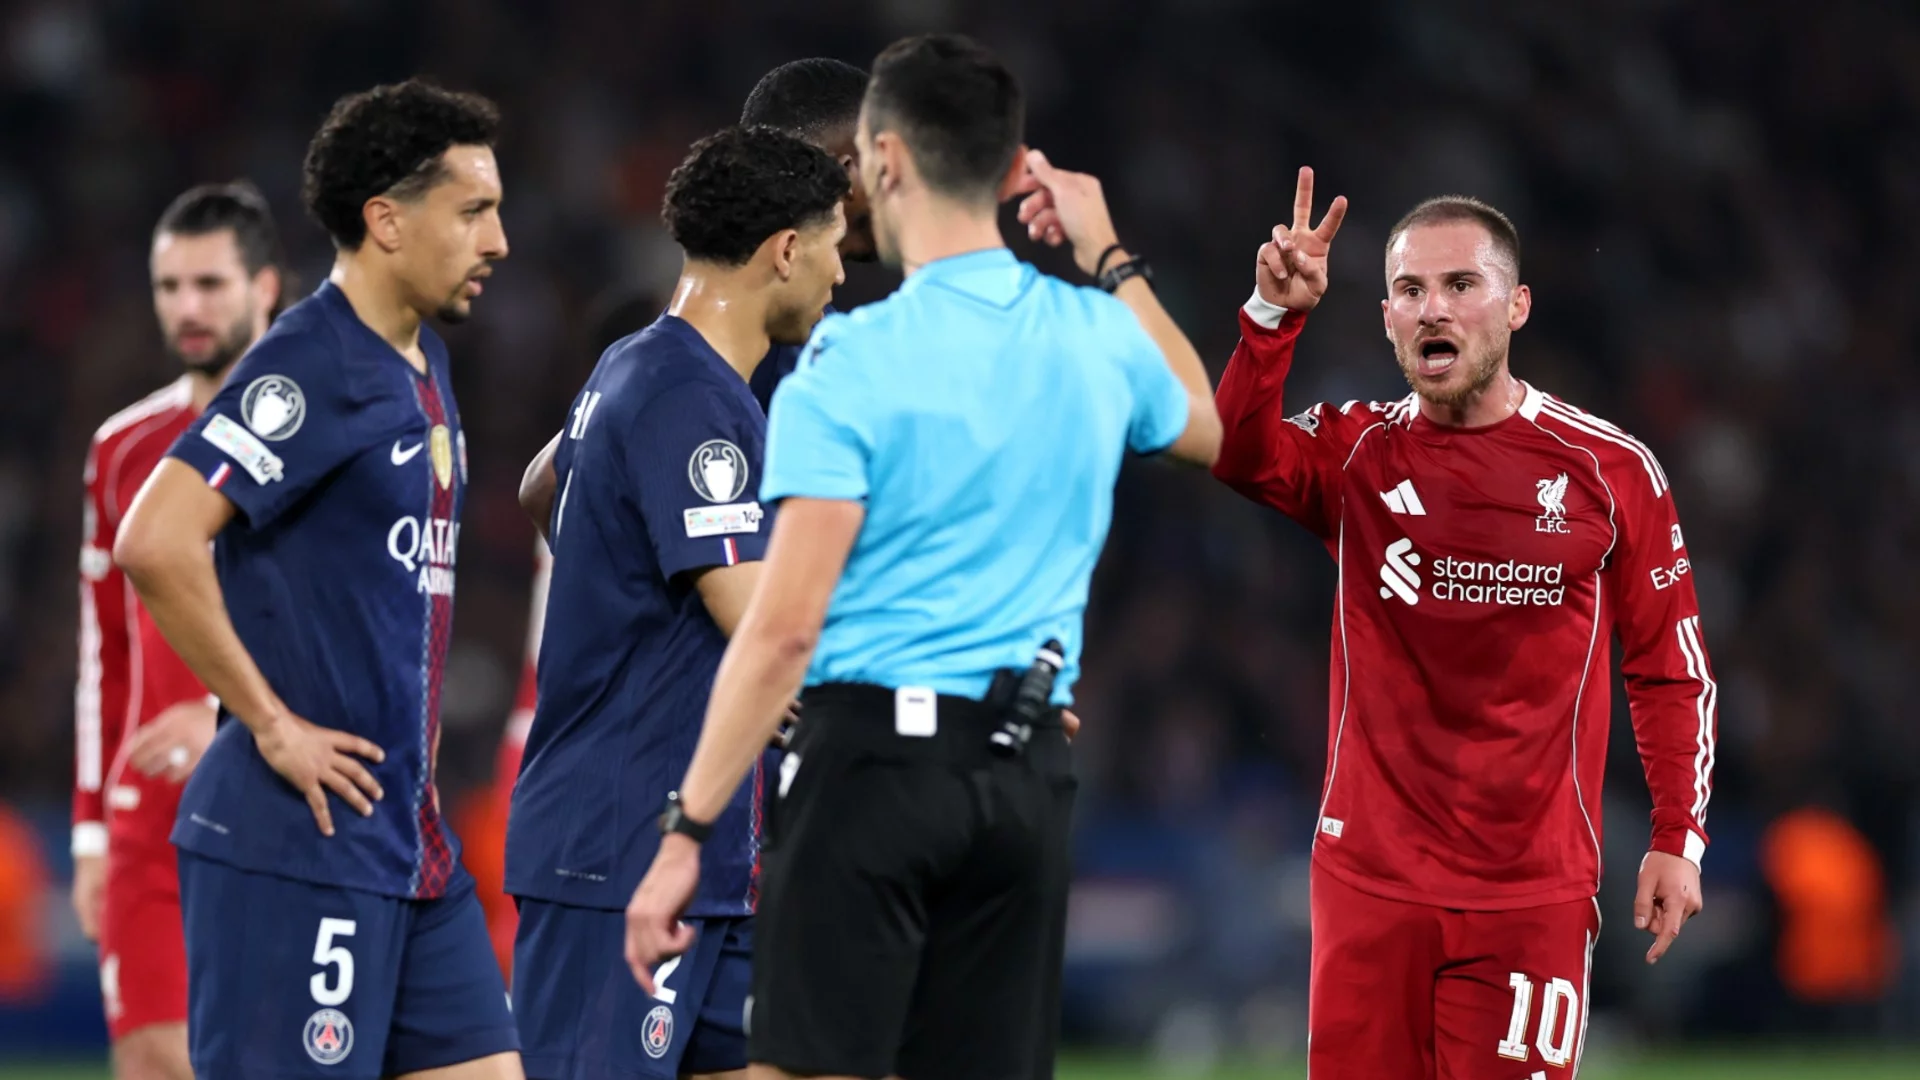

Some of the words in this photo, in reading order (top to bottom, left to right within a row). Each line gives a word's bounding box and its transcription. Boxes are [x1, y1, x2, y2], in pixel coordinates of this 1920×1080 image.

[1432, 555, 1563, 585] standard
[1650, 557, 1691, 590] Exe
[1432, 578, 1565, 606] chartered
[310, 917, 357, 1007] 5
[1497, 972, 1579, 1068] 10
